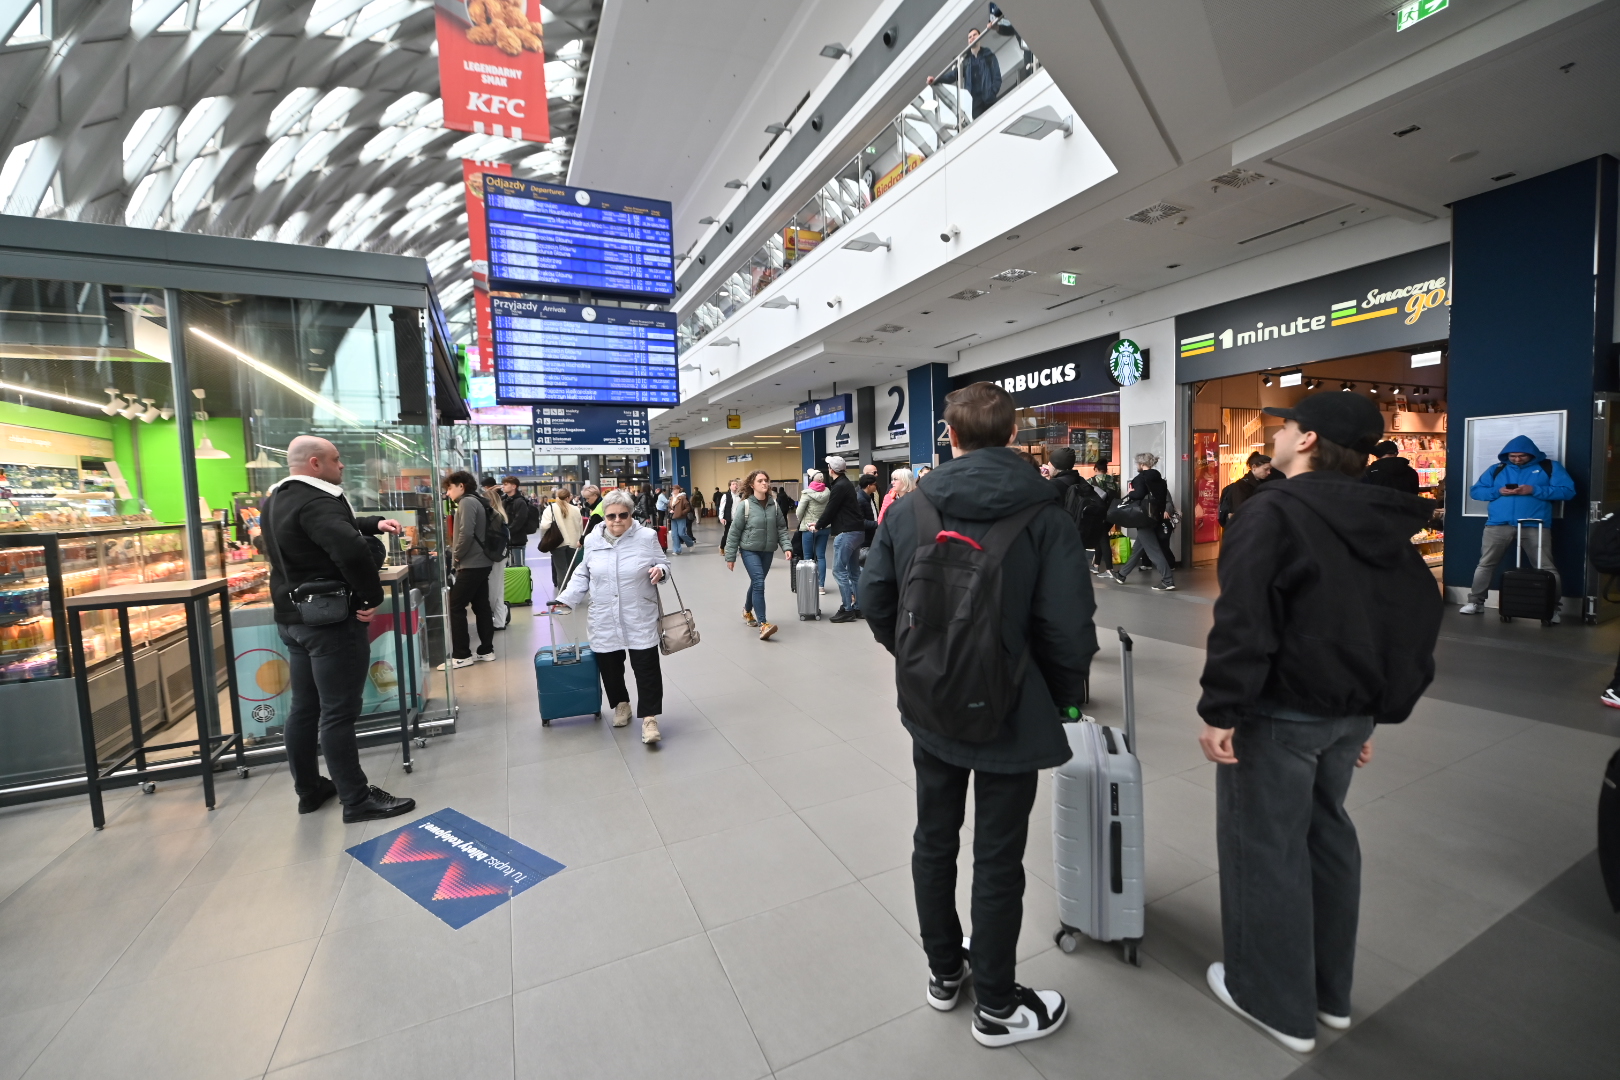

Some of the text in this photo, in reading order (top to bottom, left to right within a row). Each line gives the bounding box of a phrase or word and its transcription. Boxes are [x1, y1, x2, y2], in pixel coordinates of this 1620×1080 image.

[463, 59, 523, 80] LEGENDARNY
[481, 73, 509, 88] SMAK
[466, 91, 526, 118] KFC
[486, 176, 526, 192] Odjazdy
[531, 185, 566, 197] Departures
[877, 160, 918, 198] Biedroa
[1361, 276, 1448, 309] Smaczne
[493, 299, 538, 313] Przyjazdy
[543, 305, 567, 314] Arrivals
[1219, 314, 1327, 349] 1 minute
[988, 363, 1077, 394] ARBUCKS
[887, 386, 905, 431] 2
[937, 418, 950, 442] 2
[681, 466, 686, 476] 1
[418, 822, 528, 884] Tu kupisz bilety kolejowe!
